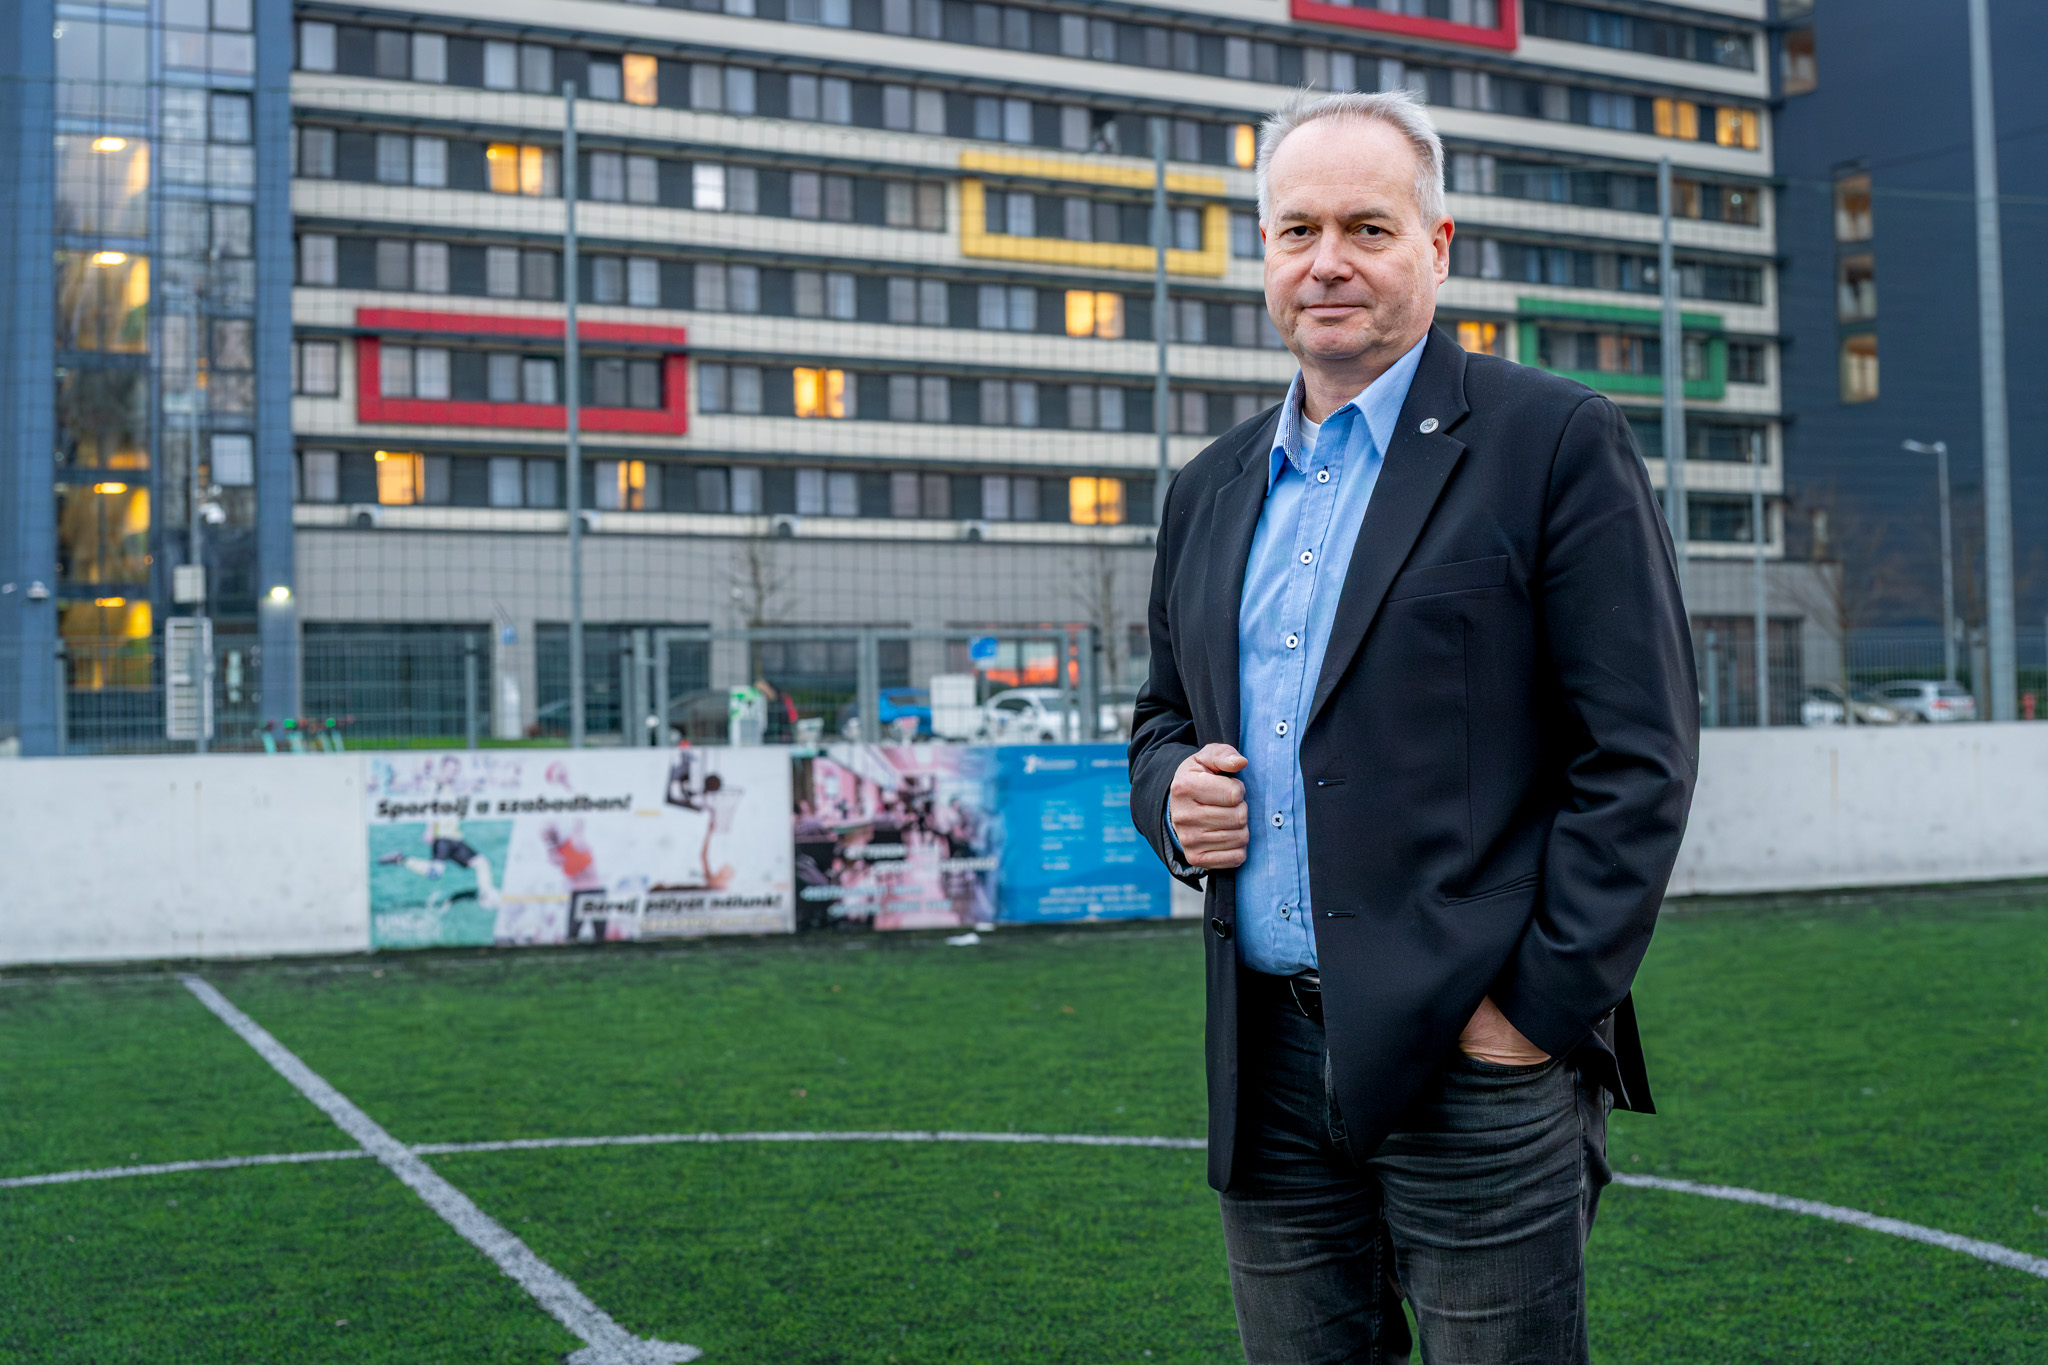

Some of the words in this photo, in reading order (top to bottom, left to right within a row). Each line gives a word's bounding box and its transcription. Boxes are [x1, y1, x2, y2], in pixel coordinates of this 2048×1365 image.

[377, 796, 468, 819] Sportolj
[476, 800, 489, 814] a
[498, 794, 632, 814] szabadban!
